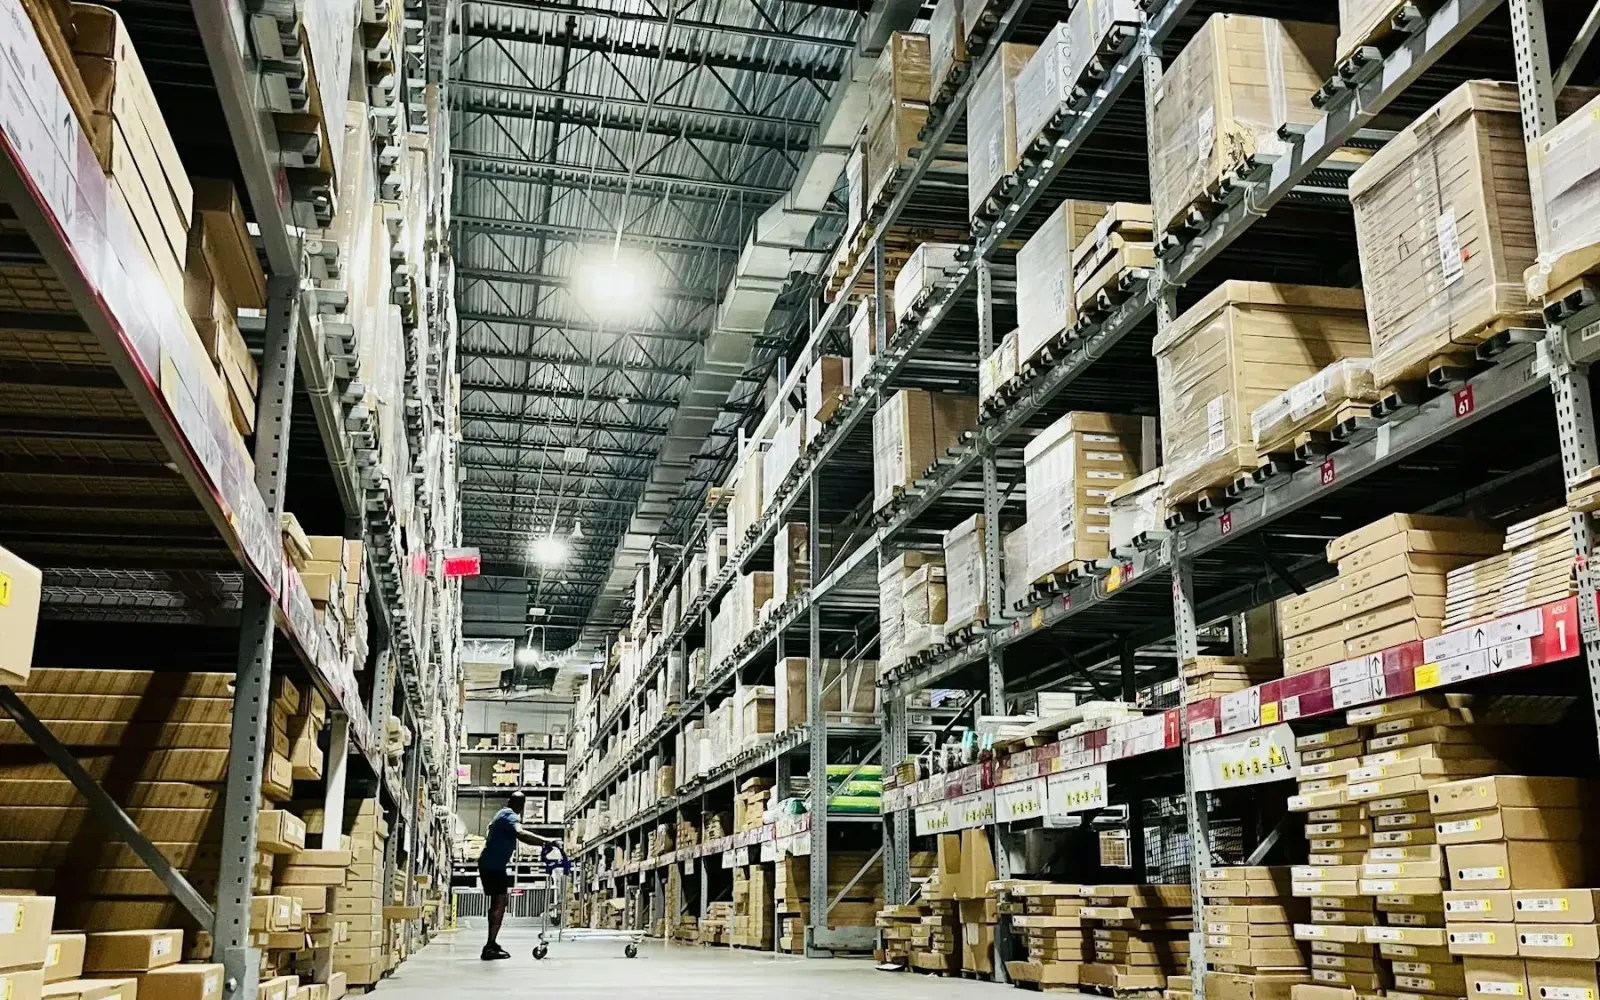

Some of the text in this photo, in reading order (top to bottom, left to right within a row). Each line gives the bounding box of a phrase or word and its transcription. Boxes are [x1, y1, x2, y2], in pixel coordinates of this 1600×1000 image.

[1458, 399, 1469, 415] 61
[1323, 469, 1333, 484] 62
[1222, 521, 1231, 534] 63
[1551, 603, 1568, 615] AISLE
[1555, 619, 1567, 652] 1
[1170, 721, 1175, 743] 1
[1224, 767, 1229, 777] 1
[1238, 764, 1244, 776] 2
[1253, 762, 1260, 773] 3
